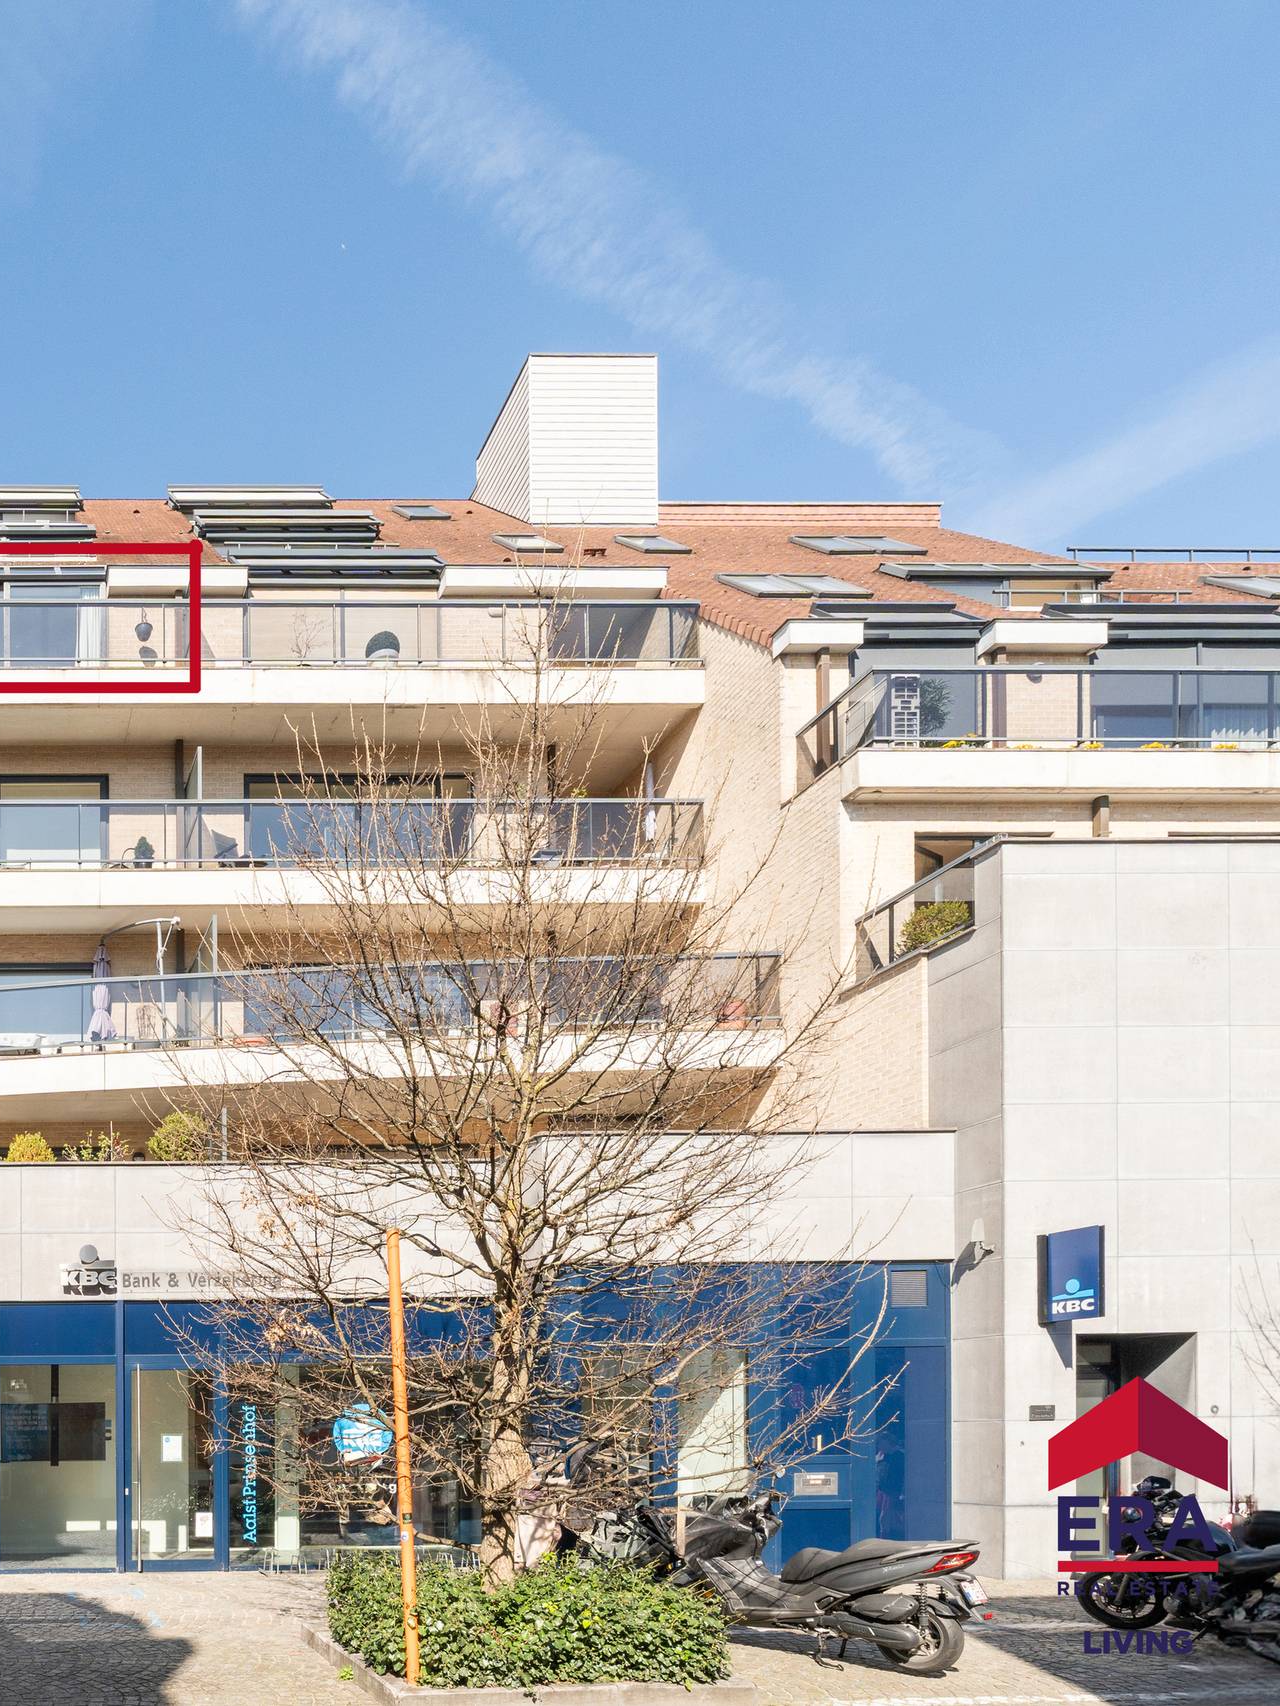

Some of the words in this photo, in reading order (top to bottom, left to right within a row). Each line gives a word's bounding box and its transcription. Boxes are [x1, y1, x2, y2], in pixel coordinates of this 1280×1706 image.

[60, 1270, 118, 1287] KBC
[122, 1273, 161, 1288] Bank
[167, 1273, 179, 1288] &
[1052, 1298, 1095, 1315] KBC
